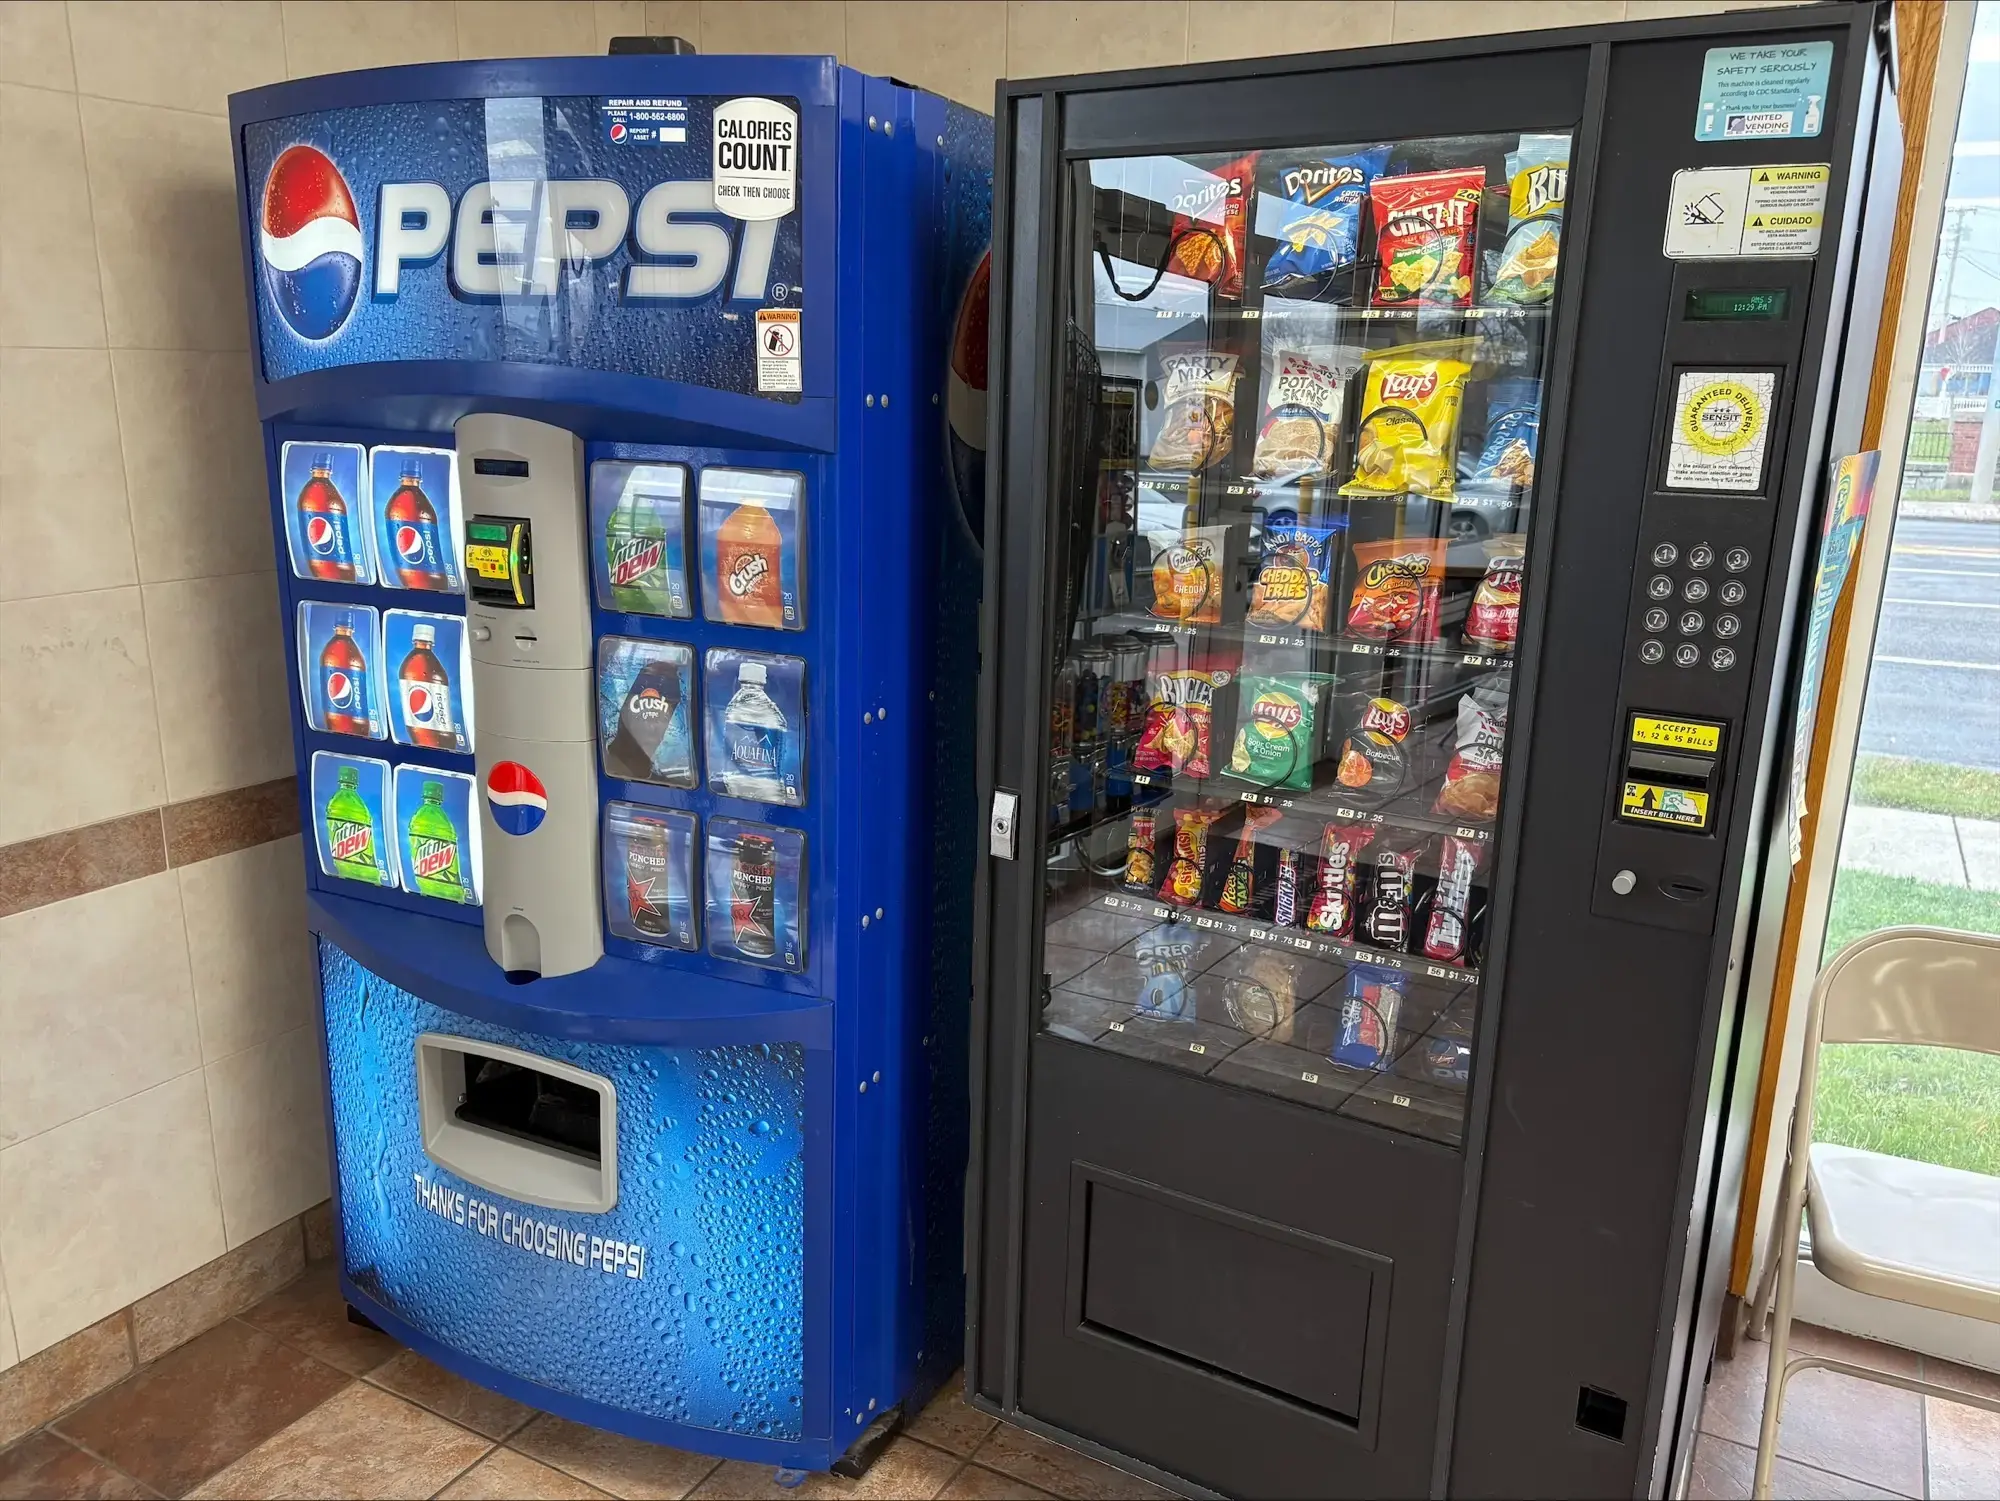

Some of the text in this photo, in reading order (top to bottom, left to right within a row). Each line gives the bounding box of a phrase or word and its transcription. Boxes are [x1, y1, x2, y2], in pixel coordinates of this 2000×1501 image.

[1729, 48, 1807, 60] WE TAKE YOUR
[1716, 62, 1817, 75] SAFETY SERIOUSLY
[1761, 78, 1784, 86] cleaned
[1756, 88, 1770, 96] CDC
[629, 112, 685, 122] 1-800-562-6800
[718, 119, 792, 141] CALORIES
[1746, 122, 1789, 130] VENDING
[718, 142, 792, 172] COUNT
[1284, 166, 1364, 197] Doritos
[1776, 172, 1820, 180] WARNING
[718, 185, 790, 200] CHECK THEN CHOOSE
[1172, 178, 1242, 211] Doritos
[1770, 216, 1812, 225] CUIDADO
[374, 179, 780, 301] PEPSI
[1734, 304, 1754, 312] 12:29
[1166, 356, 1230, 373] PARTY
[1178, 368, 1216, 383] MIX
[1278, 376, 1330, 401] POTATO
[1382, 371, 1436, 400] Lay's
[1282, 388, 1324, 408] SKINS
[1690, 388, 1753, 434] GUARANTEED DELIVERY
[335, 520, 347, 555] pepsi
[1264, 528, 1290, 552] ANDY
[427, 529, 438, 565] pepsi
[1172, 546, 1212, 568] Goldfish
[1662, 548, 1741, 564] 1 2 3
[730, 554, 768, 597] Crush
[1260, 568, 1320, 587] CHEDDAR
[1364, 552, 1431, 588] Cheetos
[1263, 584, 1308, 601] FRIES
[1656, 582, 1736, 598] 4 5 6
[1654, 614, 1731, 631] 7 8 9
[1466, 656, 1479, 664] 37
[1684, 649, 1690, 660] 0
[352, 677, 362, 710] pepsi
[435, 692, 446, 726] pepsi
[630, 695, 668, 715] Crush
[642, 711, 659, 720] Grape
[1365, 708, 1406, 736] Lay's
[1654, 723, 1698, 734] ACCEPTS
[1248, 738, 1290, 753] Sour Cream
[1474, 730, 1504, 751] POT
[1636, 730, 1646, 738] $1,
[1651, 732, 1660, 740] $2
[1674, 734, 1684, 742] $5
[1687, 736, 1714, 746] BILLS
[730, 740, 777, 768] AQUAFINA
[1260, 748, 1282, 758] Onion
[1365, 748, 1400, 762] Barbecue
[1357, 811, 1367, 819] $1
[1370, 814, 1383, 822] .25
[1630, 806, 1696, 822] INSERT BILL HERE
[1459, 828, 1472, 836] 47
[628, 852, 666, 866] PUNCHED
[733, 870, 772, 885] PUNCHED
[1320, 840, 1350, 931] Skittles
[1252, 930, 1263, 938] 53
[1358, 953, 1369, 961] 55
[1430, 968, 1442, 976] 56
[413, 1172, 645, 1280] THANKS FOR CHOOSING PEPSI
